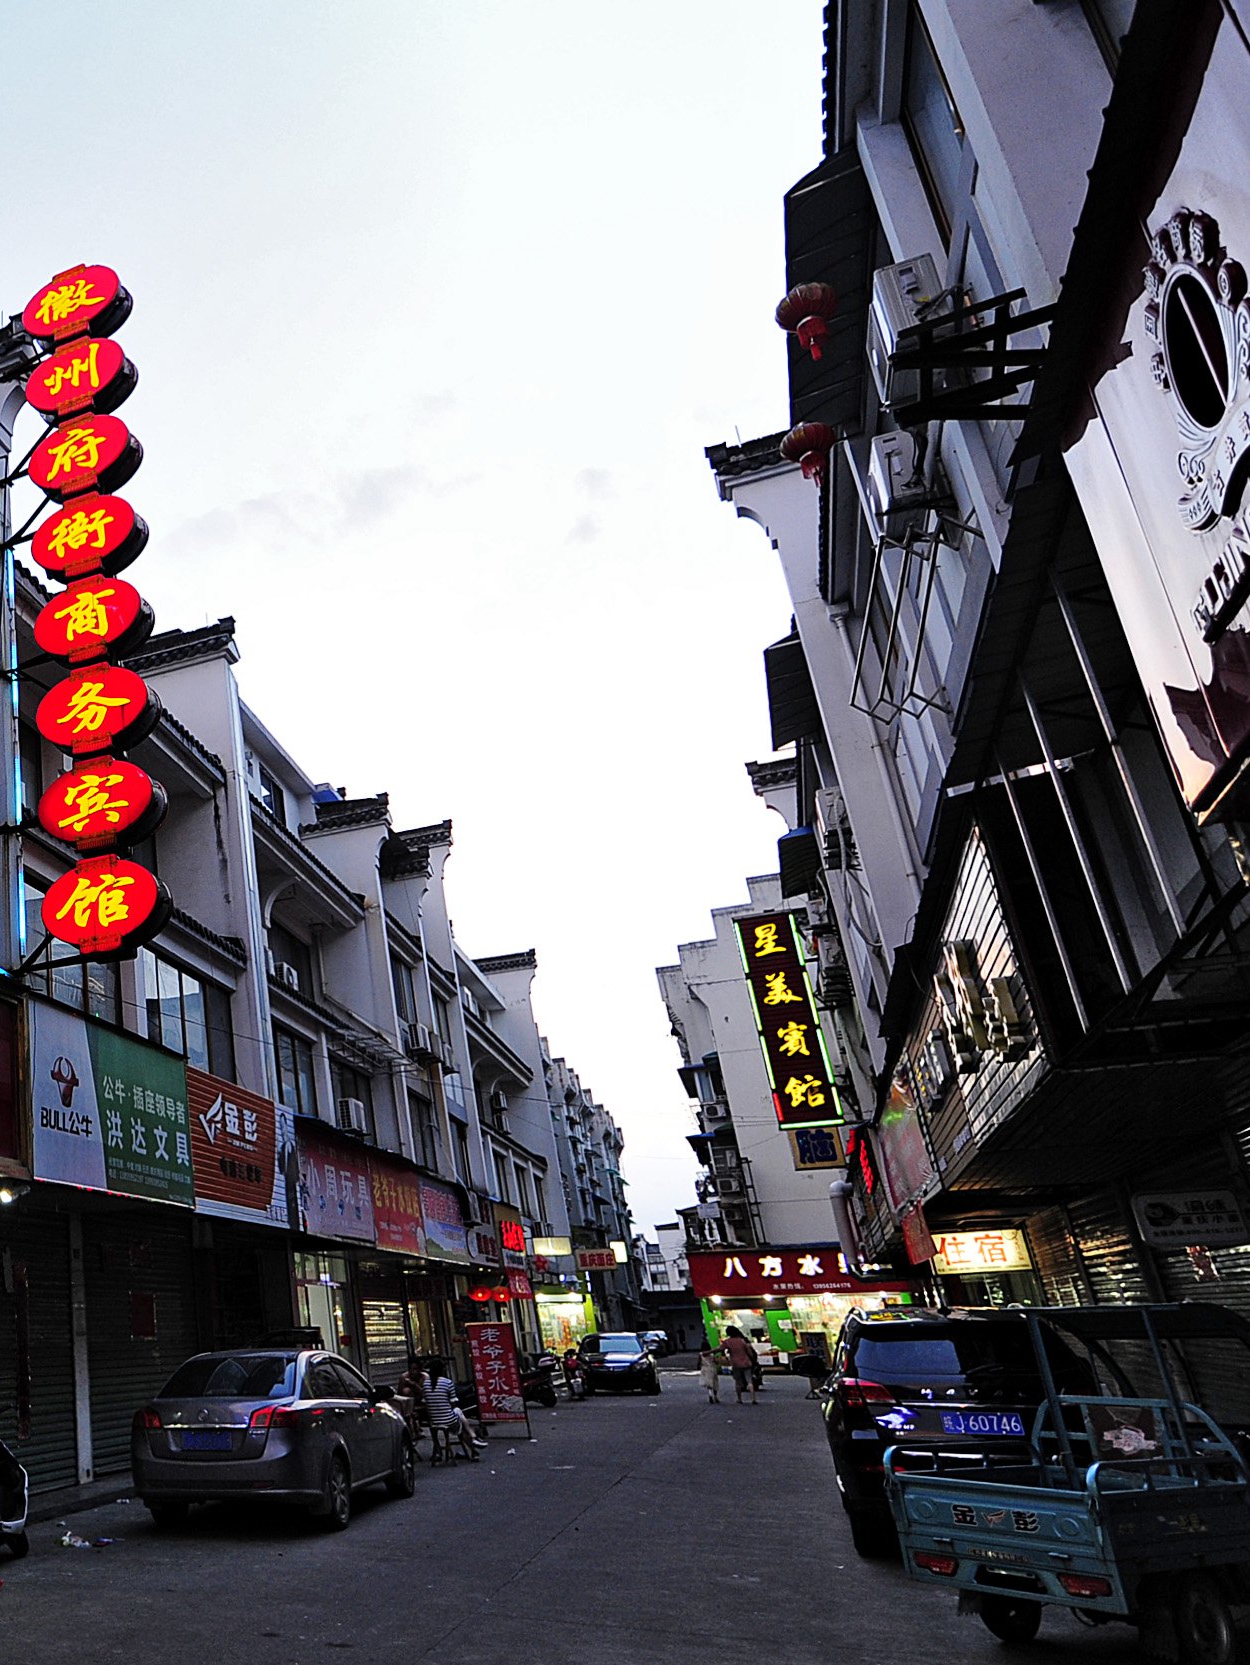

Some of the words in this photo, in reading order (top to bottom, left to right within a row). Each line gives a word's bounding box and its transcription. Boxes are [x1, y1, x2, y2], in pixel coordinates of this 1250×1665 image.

[40, 1106, 93, 1138] BULL公牛
[106, 1109, 190, 1167] 洪达文具
[224, 1100, 258, 1142] 金彭
[306, 1158, 370, 1207] 小周玩具
[722, 1252, 849, 1278] 八方水
[937, 1233, 1007, 1267] 住宿
[479, 1327, 512, 1412] 老爷子水饺
[952, 1504, 1039, 1533] 金彭
